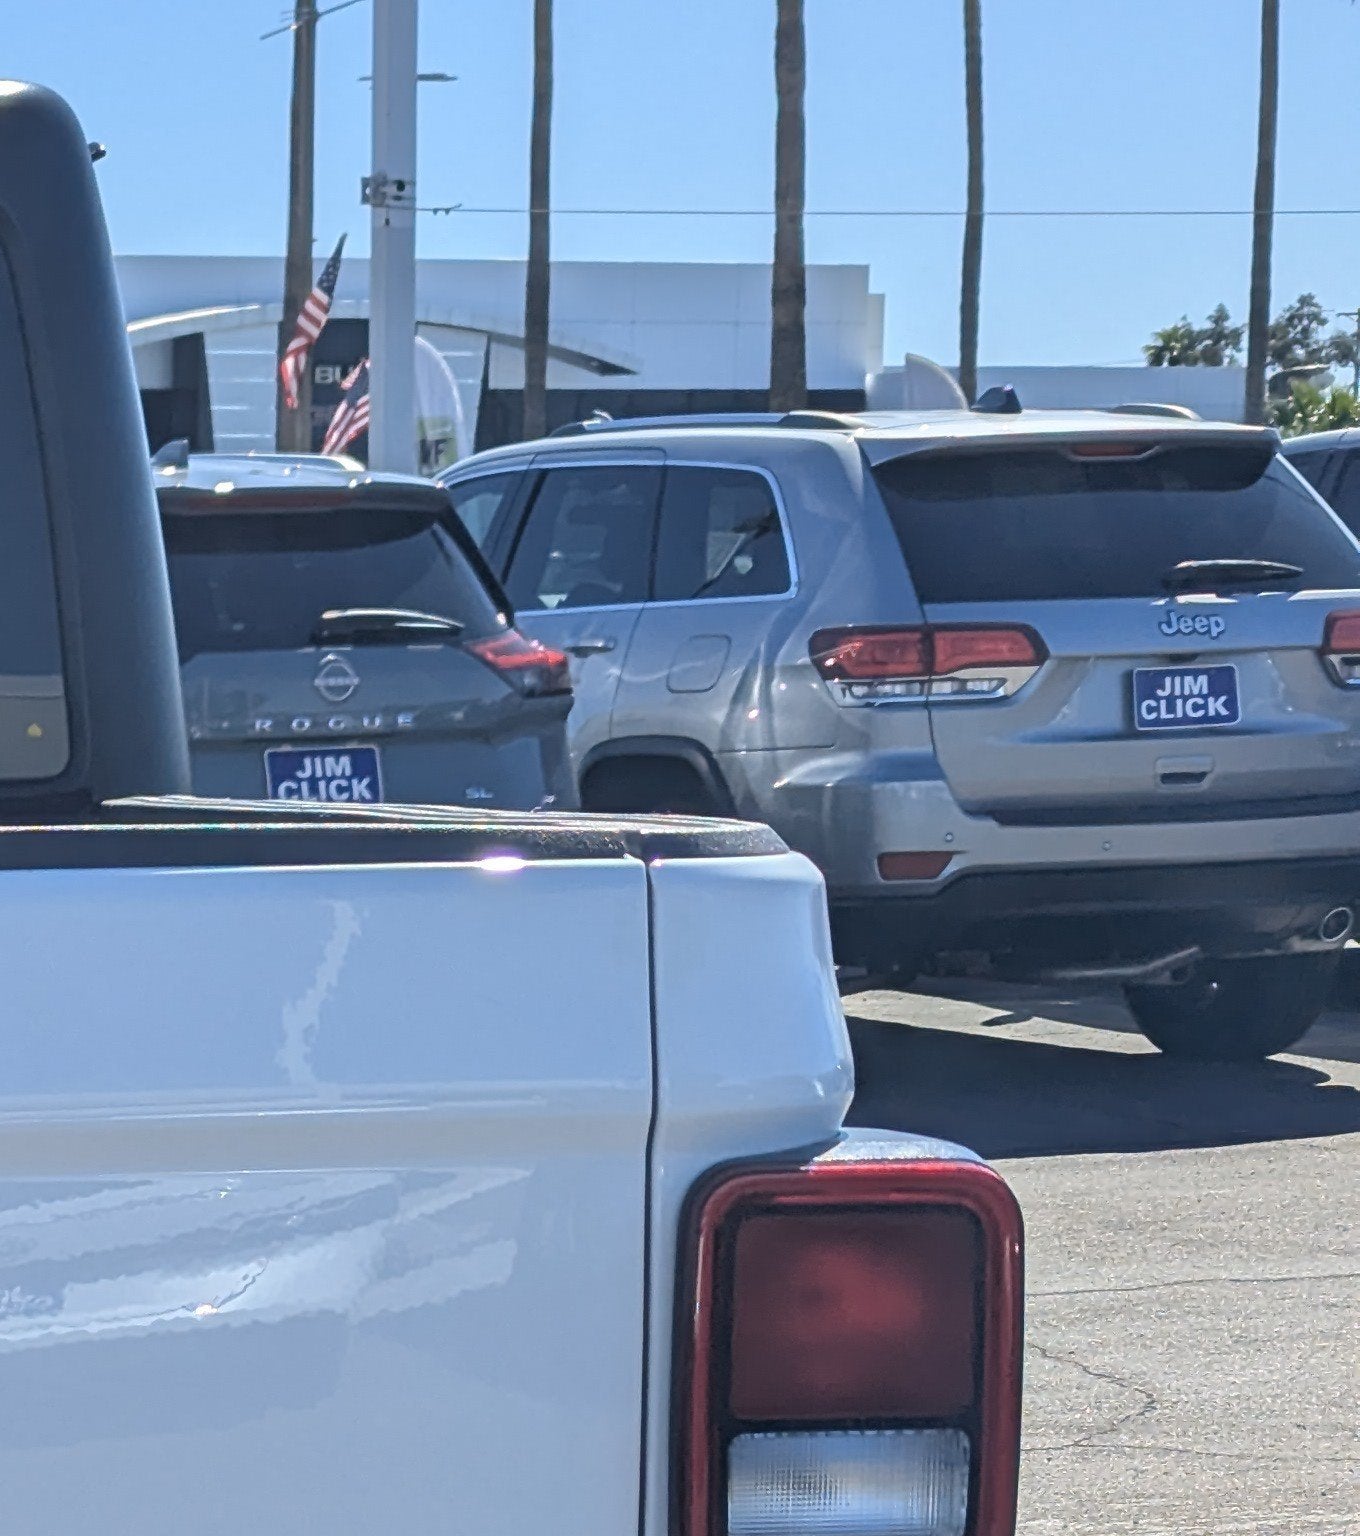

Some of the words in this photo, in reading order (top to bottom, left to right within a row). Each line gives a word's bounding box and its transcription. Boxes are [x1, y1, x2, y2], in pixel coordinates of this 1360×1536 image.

[1158, 609, 1227, 640] Jeep
[1156, 674, 1209, 697] JIM
[1140, 695, 1230, 721] CLICK
[253, 711, 416, 733] ROGUE
[295, 755, 353, 779] JIM
[277, 777, 373, 802] CLICK
